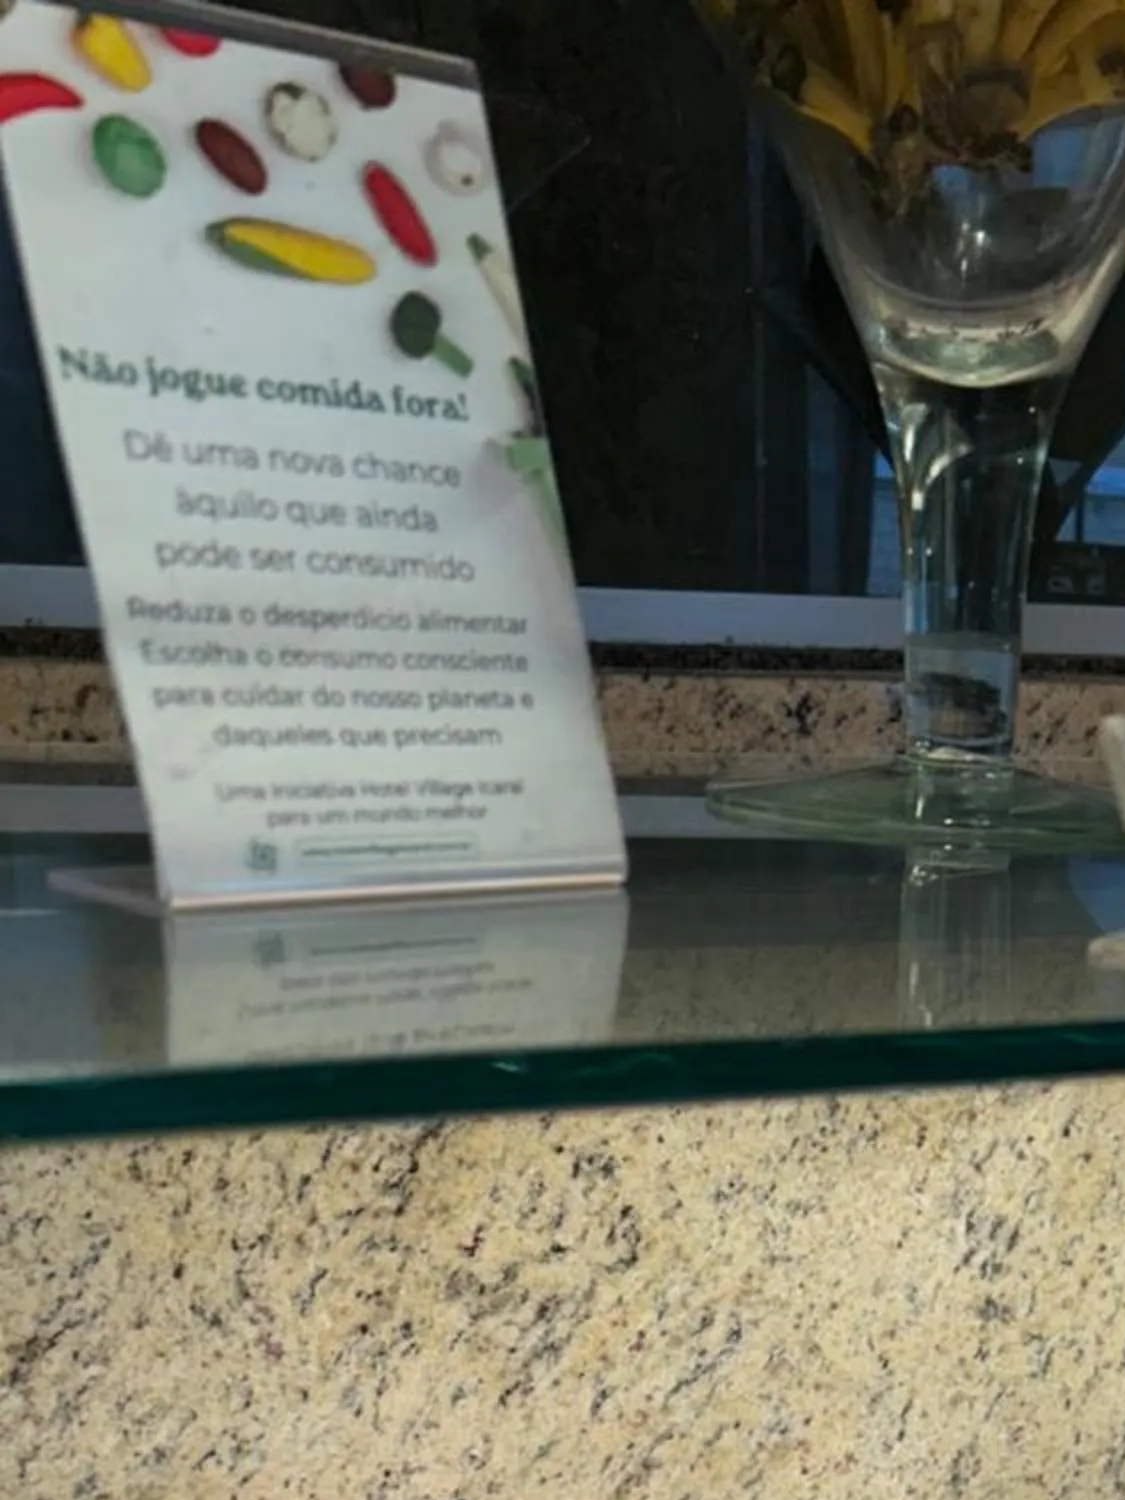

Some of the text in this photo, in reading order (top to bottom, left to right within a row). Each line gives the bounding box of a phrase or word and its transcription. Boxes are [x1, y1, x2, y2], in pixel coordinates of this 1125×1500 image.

[57, 346, 470, 422] Não jogue comida fora!
[123, 428, 462, 488] Dê uma nova chance
[285, 499, 347, 529] que
[355, 500, 439, 533] ainda
[154, 537, 476, 582] pode ser consumido
[127, 596, 232, 625] Reduza
[238, 605, 257, 626] o
[418, 607, 528, 635] alimentar
[139, 638, 529, 673] Escolha o consumo consciente
[153, 683, 536, 713] para cuidar do nosso planeta e
[213, 723, 503, 752] daqueles que precisam
